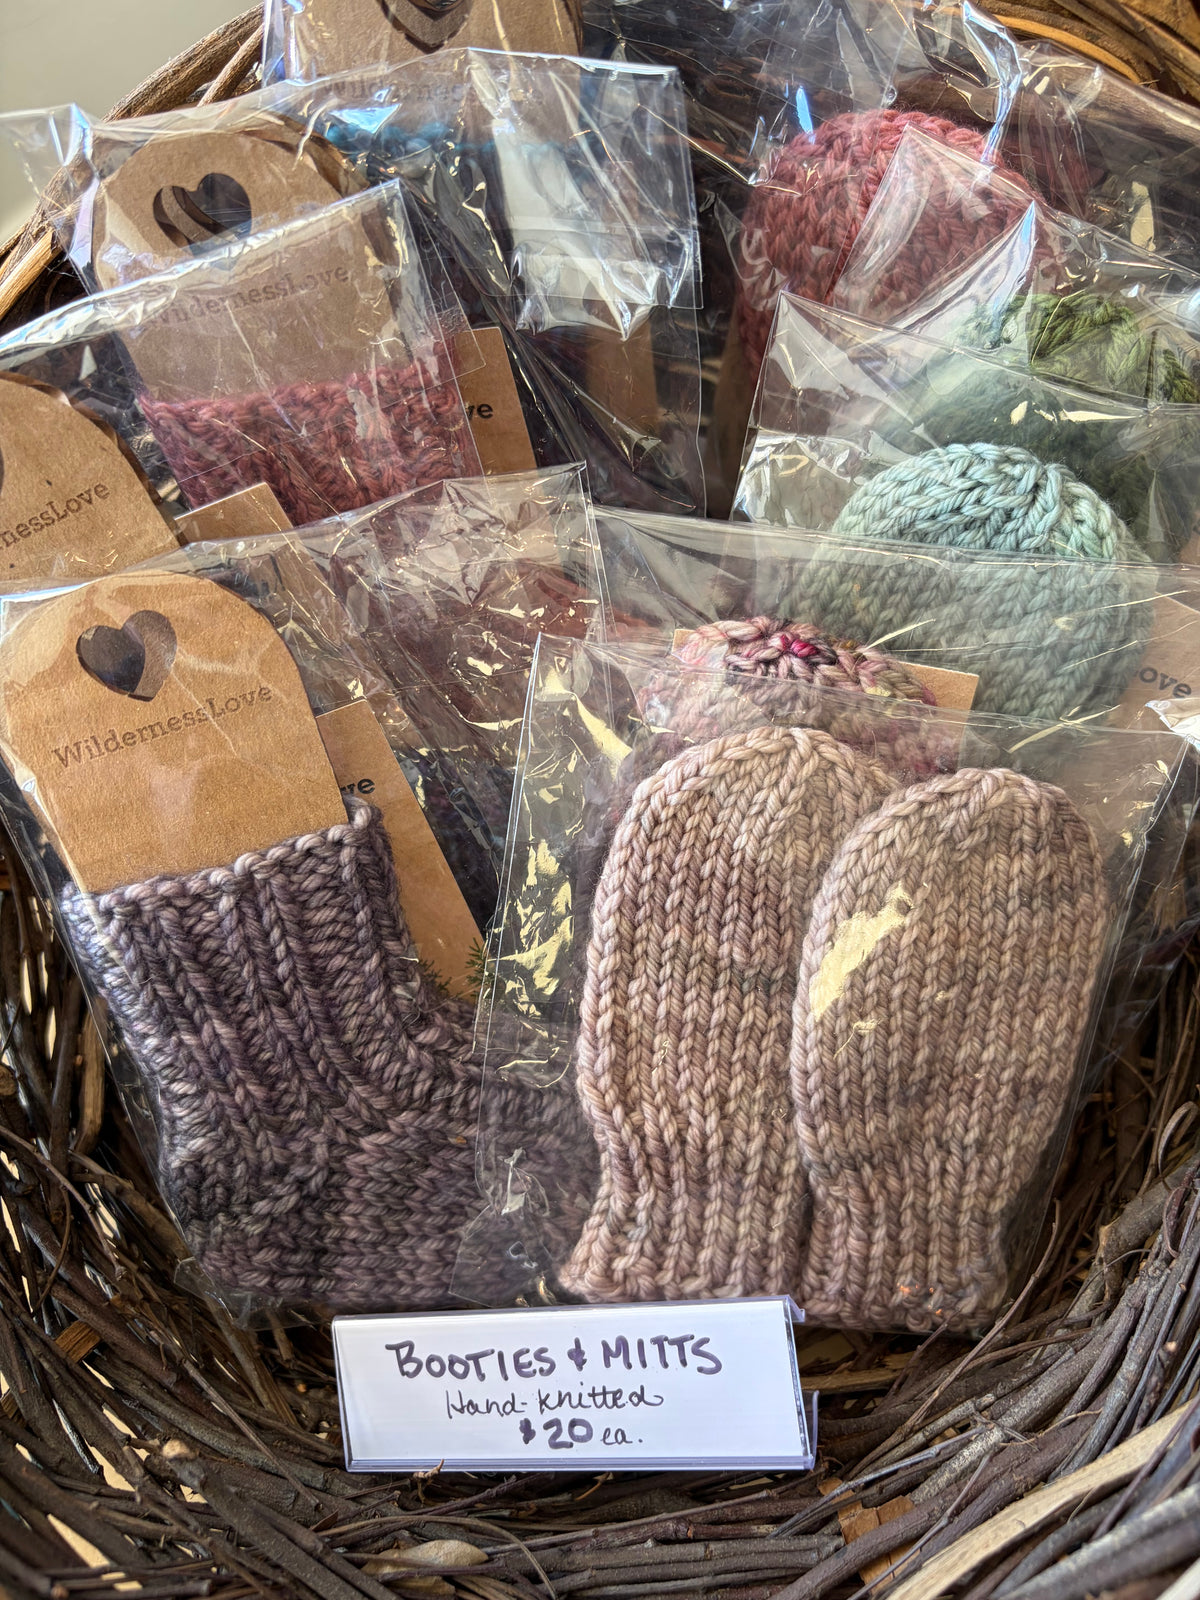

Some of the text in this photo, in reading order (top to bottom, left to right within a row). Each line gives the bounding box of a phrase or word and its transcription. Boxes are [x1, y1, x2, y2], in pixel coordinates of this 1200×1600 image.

[0, 483, 111, 550] nessLove
[1134, 667, 1192, 699] ove
[51, 686, 273, 768] WildernessLove
[385, 1340, 556, 1382] BOOTIES
[602, 1334, 723, 1375] MITTS
[602, 1426, 644, 1447] ea.
